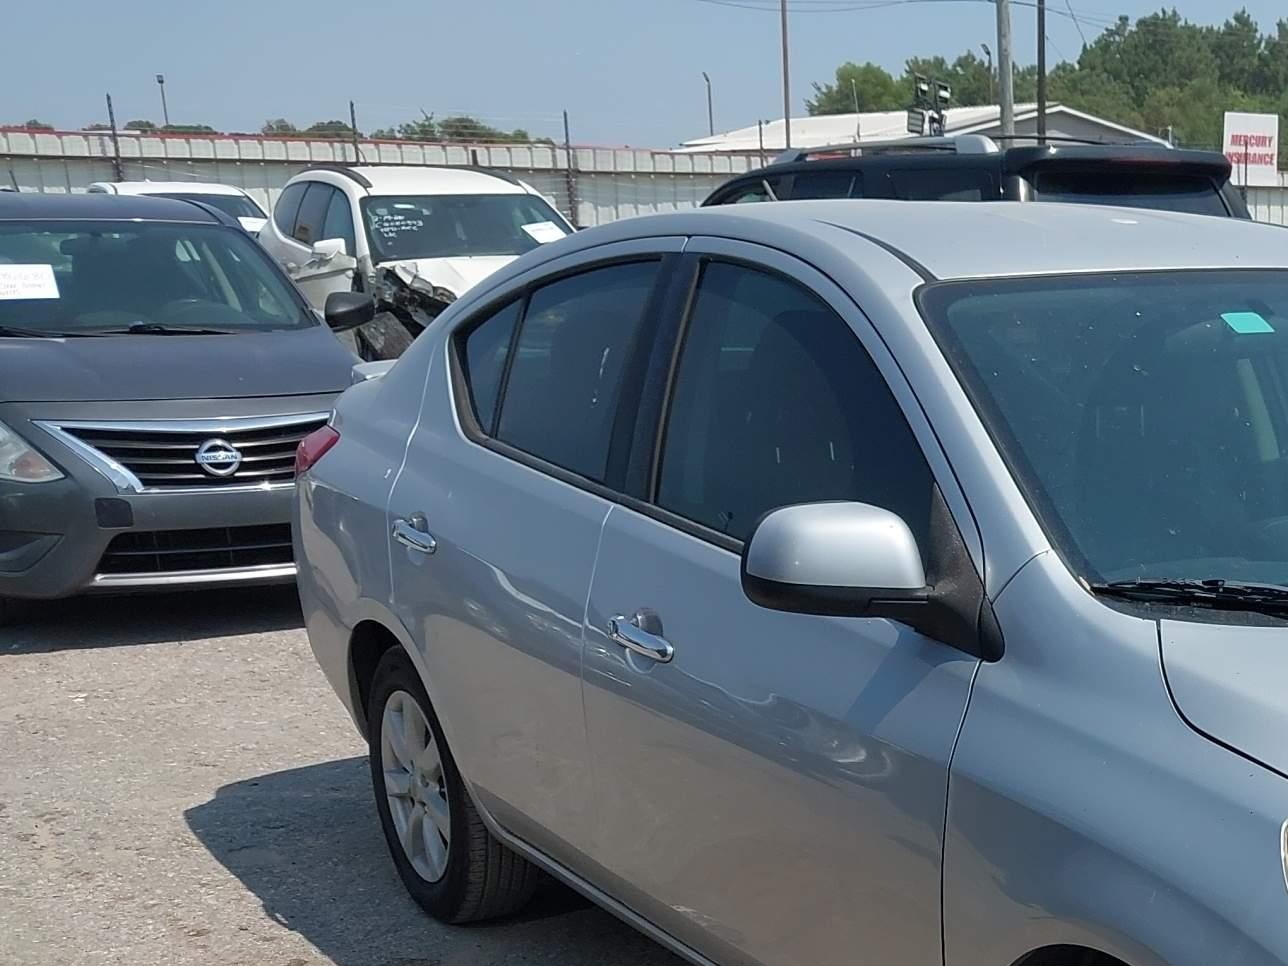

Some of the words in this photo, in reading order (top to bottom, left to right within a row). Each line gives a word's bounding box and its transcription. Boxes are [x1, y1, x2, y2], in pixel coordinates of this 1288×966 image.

[1231, 134, 1273, 147] MERCURY
[1226, 151, 1274, 165] INSURANCE
[201, 453, 238, 461] NISSAN
